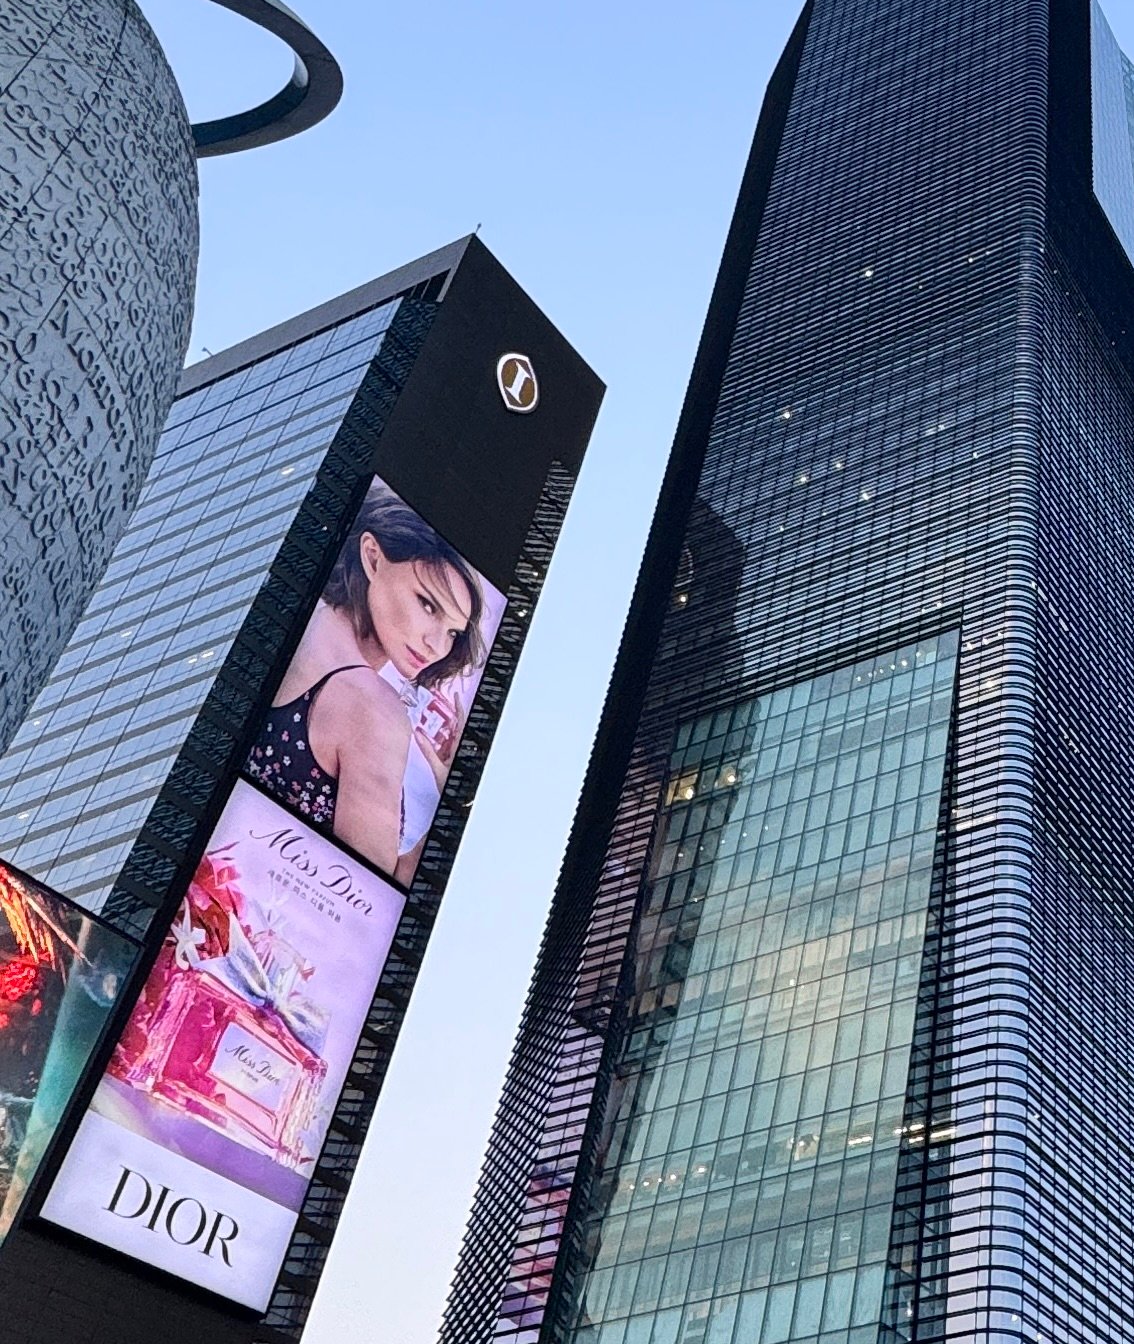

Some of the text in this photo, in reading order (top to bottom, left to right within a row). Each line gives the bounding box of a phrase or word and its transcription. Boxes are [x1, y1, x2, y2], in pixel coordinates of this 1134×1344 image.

[248, 828, 374, 917] Miss Dior
[224, 1044, 257, 1069] Miss
[101, 1164, 239, 1268] DIOR
